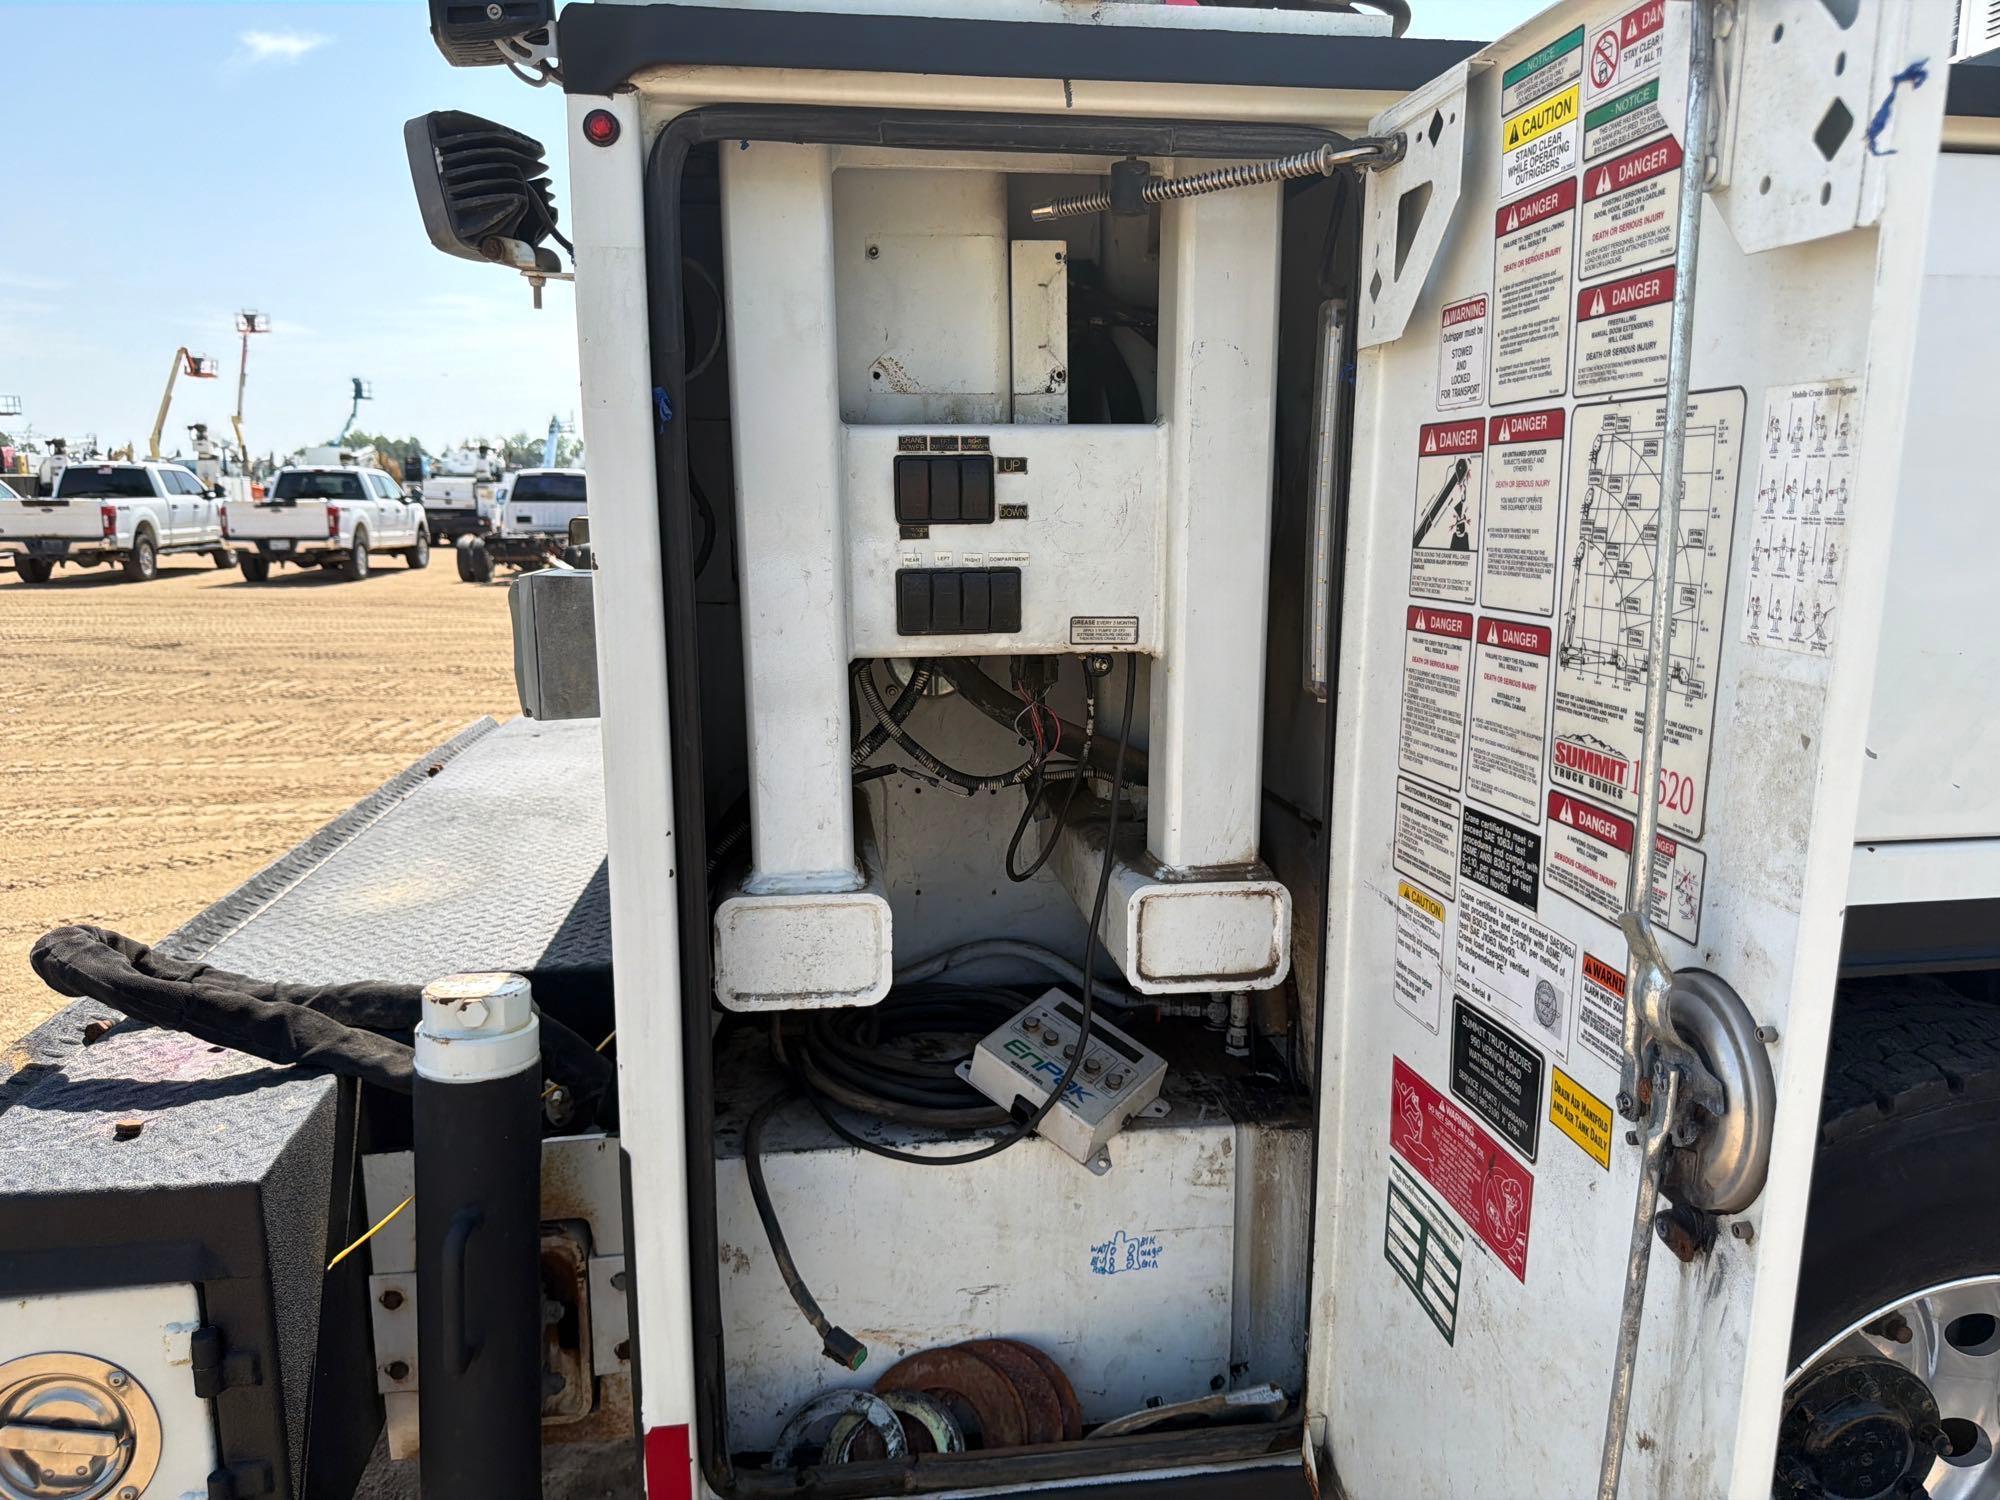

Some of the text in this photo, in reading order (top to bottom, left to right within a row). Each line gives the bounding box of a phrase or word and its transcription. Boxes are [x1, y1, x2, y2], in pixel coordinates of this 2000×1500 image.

[1642, 7, 1664, 27] DAN
[1527, 46, 1555, 71] NOTICE
[1624, 36, 1660, 62] STAY CLEAR
[1634, 54, 1655, 69] AT ALL
[1615, 88, 1649, 114] NOTICE
[1522, 96, 1572, 136] CAUTION
[1508, 141, 1570, 178] WHILE OPERATING
[1515, 132, 1562, 162] STAND CLEAR
[1515, 159, 1559, 186] OUTRIGGERS
[1619, 148, 1667, 181] DANGER
[1520, 193, 1558, 221] DANGER
[1592, 211, 1664, 242] DEATH OR SERIOUS INJURY
[1504, 247, 1561, 272] DEATH OR SERIOUS INJURY
[1612, 279, 1660, 305] DANGER
[1450, 302, 1484, 324] WARNING
[1443, 326, 1483, 344] Outrigger must be
[1451, 346, 1473, 359] STOWED
[1586, 341, 1656, 361] DEATH OR SERIOUS INJURY
[1451, 372, 1471, 385] LOCKED
[1456, 361, 1466, 371] AND
[1441, 384, 1480, 399] FOR TRANSPORT
[1825, 387, 1838, 395] Hand
[1839, 386, 1857, 395] Signals
[1511, 415, 1547, 432] DANGER
[1440, 429, 1477, 448] DANGER
[1004, 460, 1020, 471] UP
[1000, 506, 1027, 517] DOWN
[1431, 616, 1462, 632] DANGER
[1503, 629, 1538, 648] DANGER
[1429, 660, 1445, 669] SERIOUS
[1484, 673, 1496, 681] DEATH
[1503, 677, 1520, 688] SERIOUS
[1521, 682, 1536, 691] INJURY
[1555, 742, 1627, 784] SUMMIT
[1554, 764, 1623, 799] TRUCK BODIES
[1405, 784, 1452, 810] SHUTDOWN PROCEDURE
[1465, 811, 1534, 848] Crane certified to meet or
[1579, 811, 1617, 840] DANGER
[1464, 824, 1525, 856] exceed SAE test
[1463, 834, 1538, 873] procedures and comply with
[1479, 851, 1492, 863] ANSI
[1511, 865, 1532, 882] Section
[1462, 864, 1471, 876] SAE
[1479, 863, 1531, 893] per method of test
[1554, 851, 1617, 889] SERIOUS CRUSHING INJURY
[1411, 891, 1440, 917] CAUTION
[1471, 906, 1544, 951] procedures and comply with
[1476, 898, 1548, 942] certified to meet or exceed
[1457, 956, 1469, 971] Truck
[1458, 939, 1494, 968] by independent
[1473, 938, 1529, 978] load capacity verified
[1488, 925, 1564, 977] Section per of
[1593, 962, 1625, 995] WARNI
[1584, 983, 1612, 1007] ALARM MUST
[1462, 1015, 1532, 1073] SUMMIT TRUCK BODIES
[1010, 1060, 1044, 1086] REMOTE PANEL
[1482, 1044, 1504, 1066] VERNON
[1505, 1060, 1521, 1079] ROAD
[1497, 1070, 1504, 1081] KS
[1459, 1069, 1528, 1131] SERVICE PARTS WARRANTY
[1554, 1080, 1608, 1133] DRAIN AIR MANIFOLD
[1446, 1105, 1474, 1137] WARNING
[1553, 1100, 1608, 1151] AND AIR TANK DAILY
